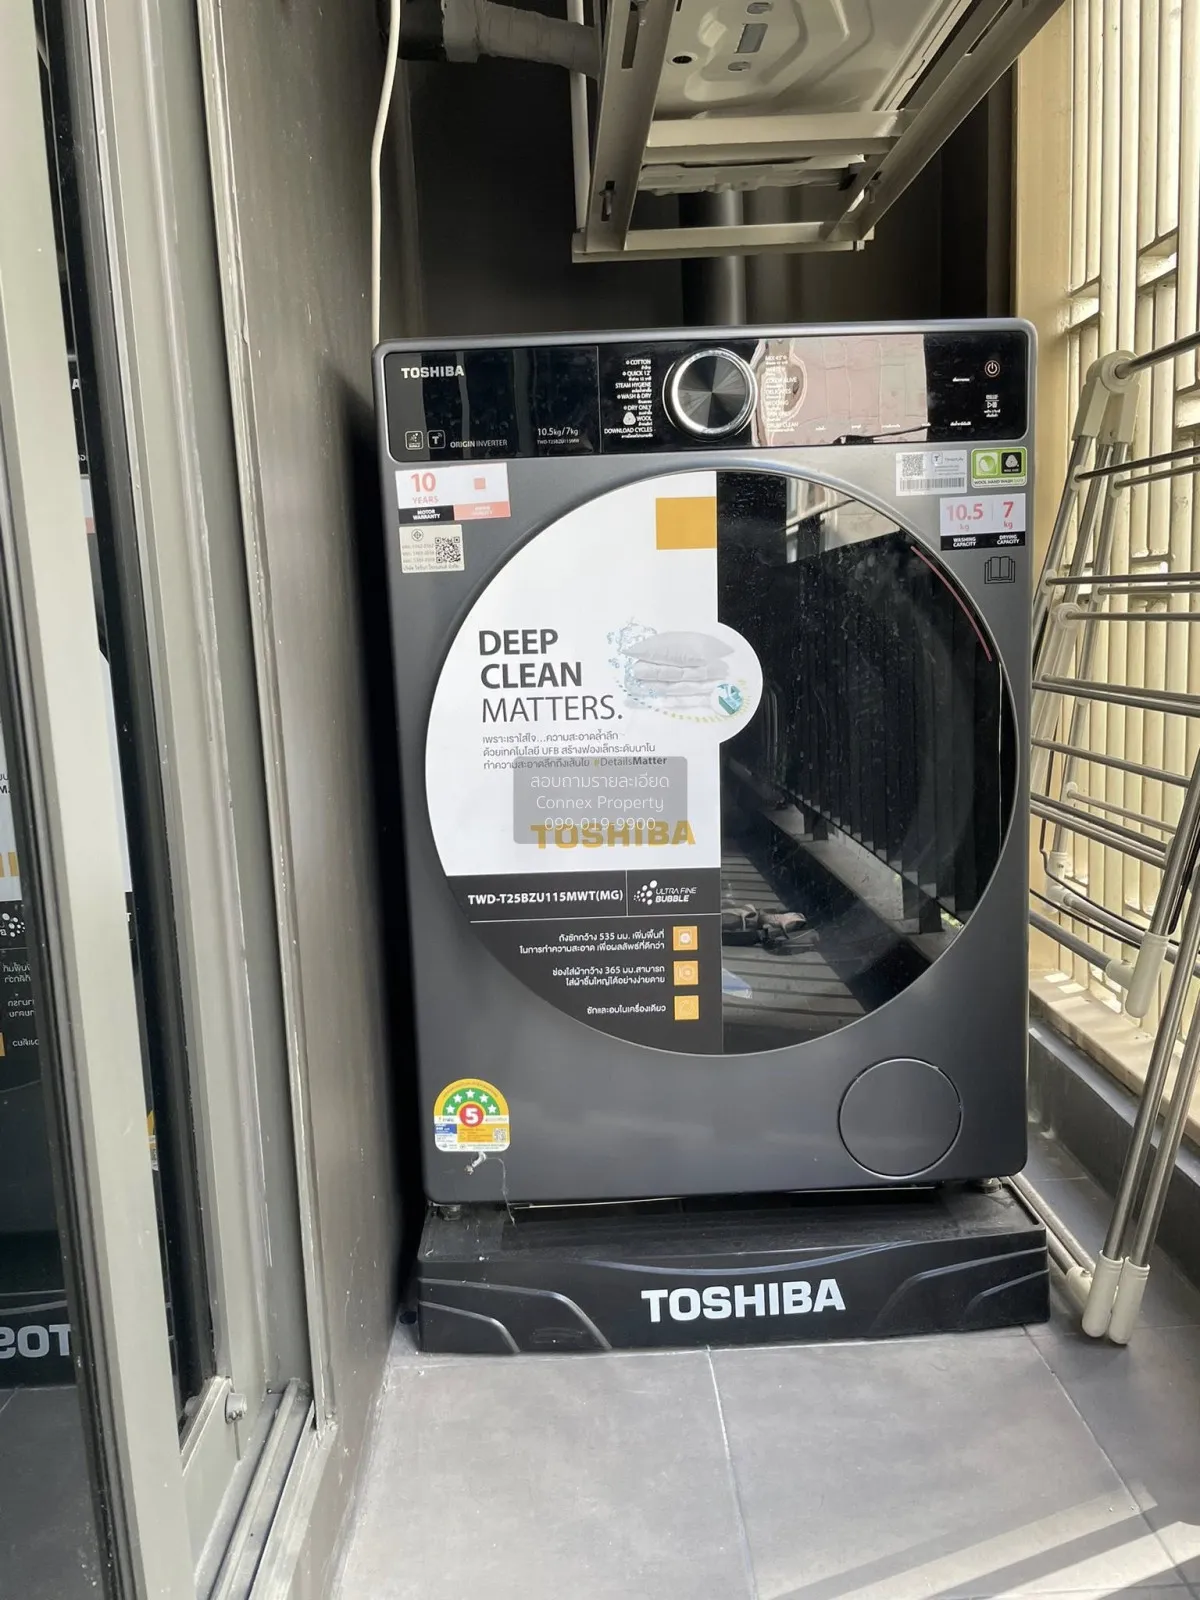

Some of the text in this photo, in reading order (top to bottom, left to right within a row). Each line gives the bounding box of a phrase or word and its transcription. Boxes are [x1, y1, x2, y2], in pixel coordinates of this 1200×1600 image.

[401, 365, 464, 379] TOSHIBA
[538, 427, 578, 437] 10.5kg/7kg
[411, 472, 436, 492] 10
[412, 496, 439, 504] YEARS
[946, 503, 984, 521] 10.5
[1003, 501, 1014, 518] 7
[1004, 519, 1013, 529] kg
[479, 628, 559, 656] DEEP
[481, 661, 582, 689] CLEAN
[482, 694, 623, 723] MATTERS.
[542, 746, 559, 755] UFB
[530, 820, 696, 849] TOSHIBA
[468, 889, 623, 905] TWD-T25BZU115MWT(MG)
[655, 886, 697, 895] ULTRA FINE
[655, 894, 690, 903] BUBBLE
[600, 932, 615, 941] 535
[605, 966, 621, 975] 365
[465, 1107, 479, 1125] 5
[641, 1279, 846, 1323] TOSHIBA
